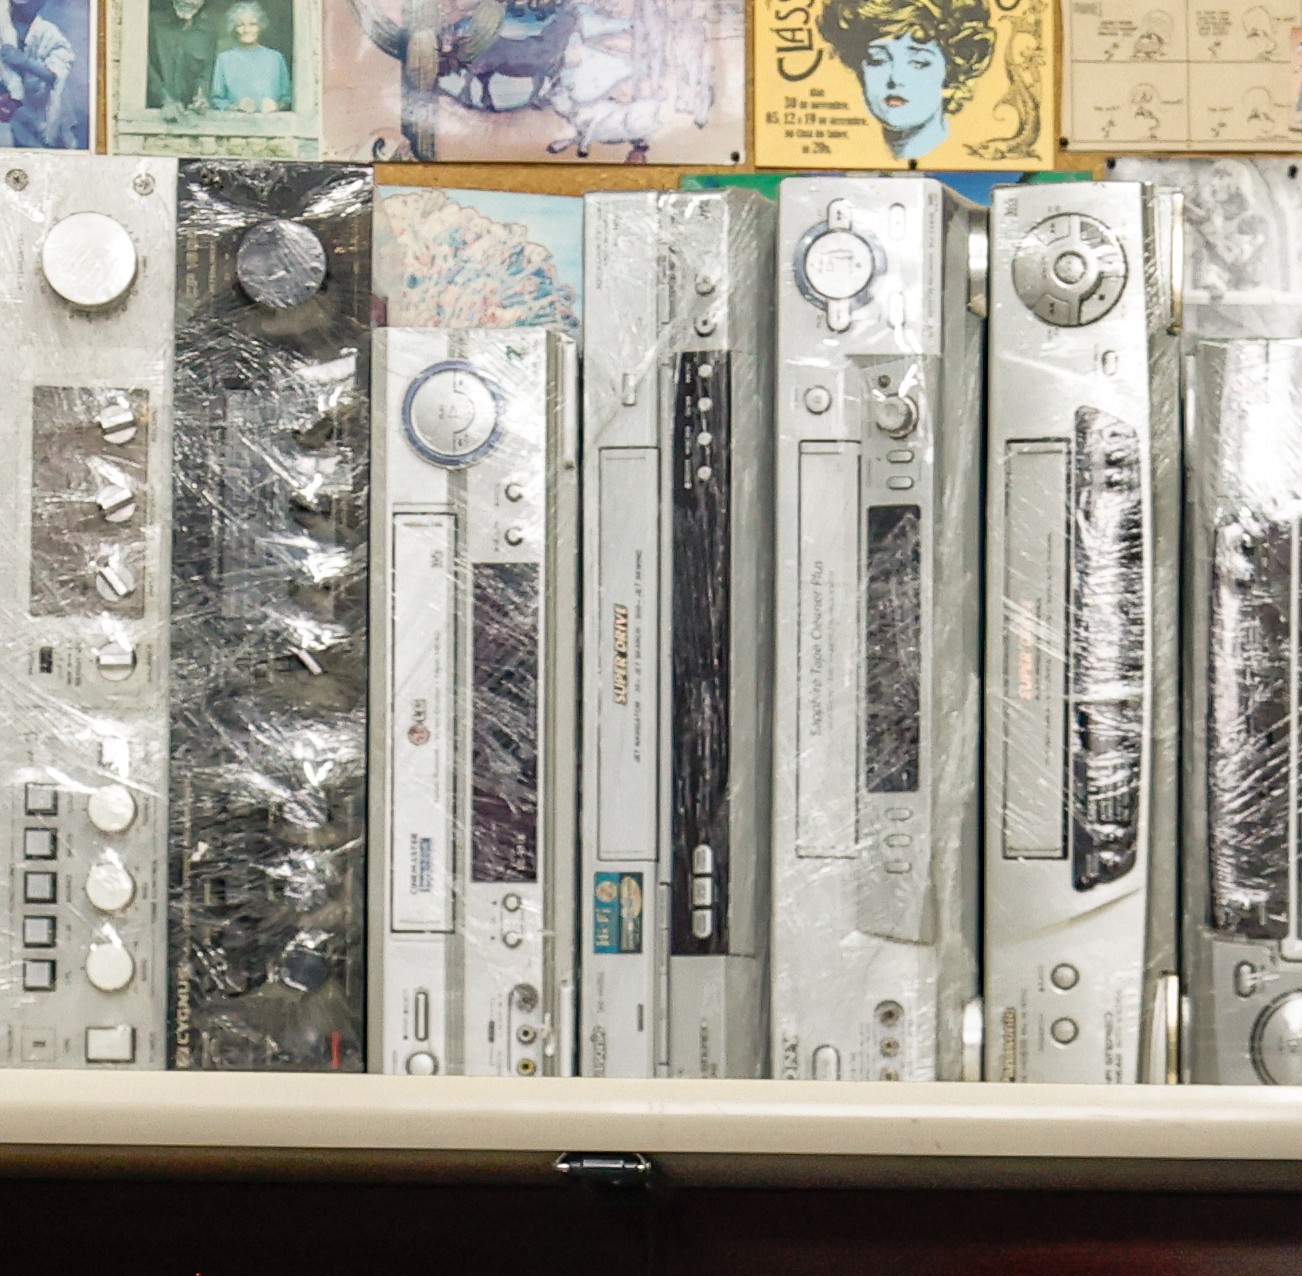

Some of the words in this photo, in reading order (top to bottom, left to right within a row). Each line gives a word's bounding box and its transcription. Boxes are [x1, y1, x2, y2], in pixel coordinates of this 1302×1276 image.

[611, 603, 627, 655] DRIVE
[611, 655, 627, 706] SUPER
[176, 966, 191, 1045] CYGNUS
